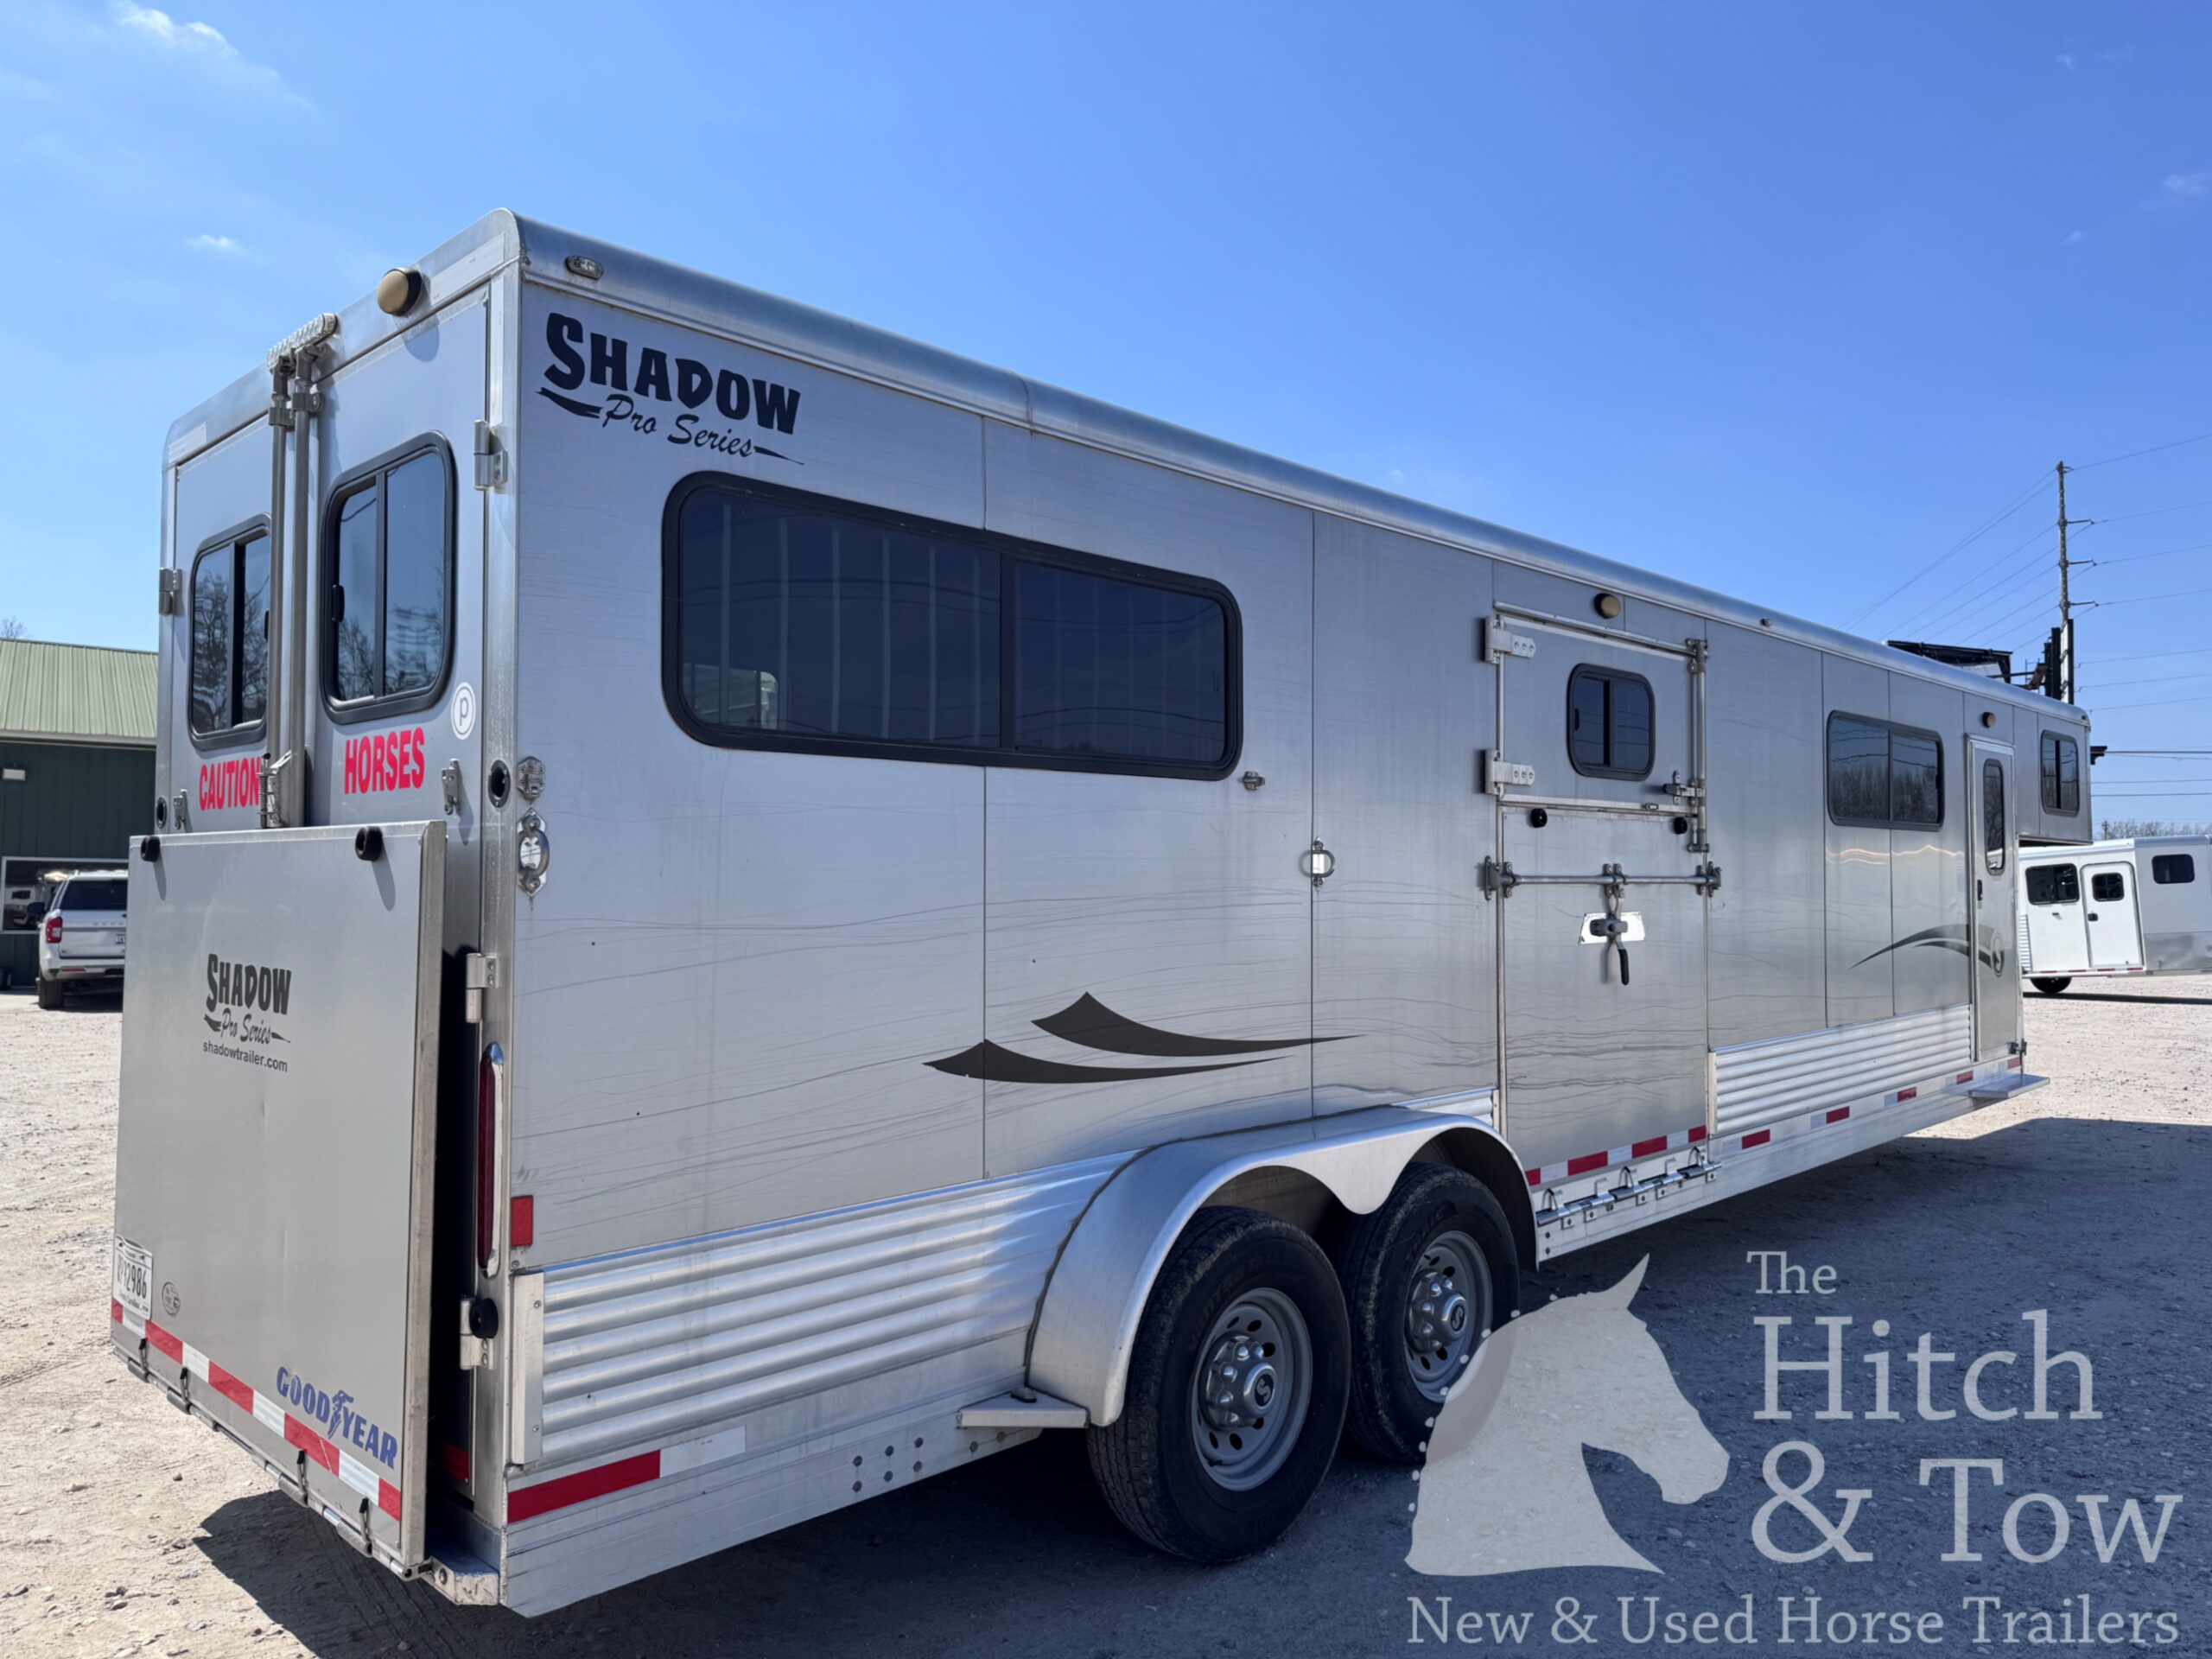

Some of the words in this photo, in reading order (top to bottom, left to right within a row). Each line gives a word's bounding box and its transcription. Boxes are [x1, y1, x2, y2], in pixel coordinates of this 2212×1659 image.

[544, 312, 801, 435] SHADOW
[602, 394, 657, 433] Pro
[667, 414, 754, 458] Series
[199, 756, 262, 811] CAUTION
[344, 727, 425, 794] HORSES
[206, 952, 292, 1015] SHADOW
[202, 1039, 289, 1072] shadowtrailer.com
[220, 1007, 238, 1038] Pro
[239, 1013, 272, 1045] Series
[276, 1366, 397, 1470] GOODYEAR
